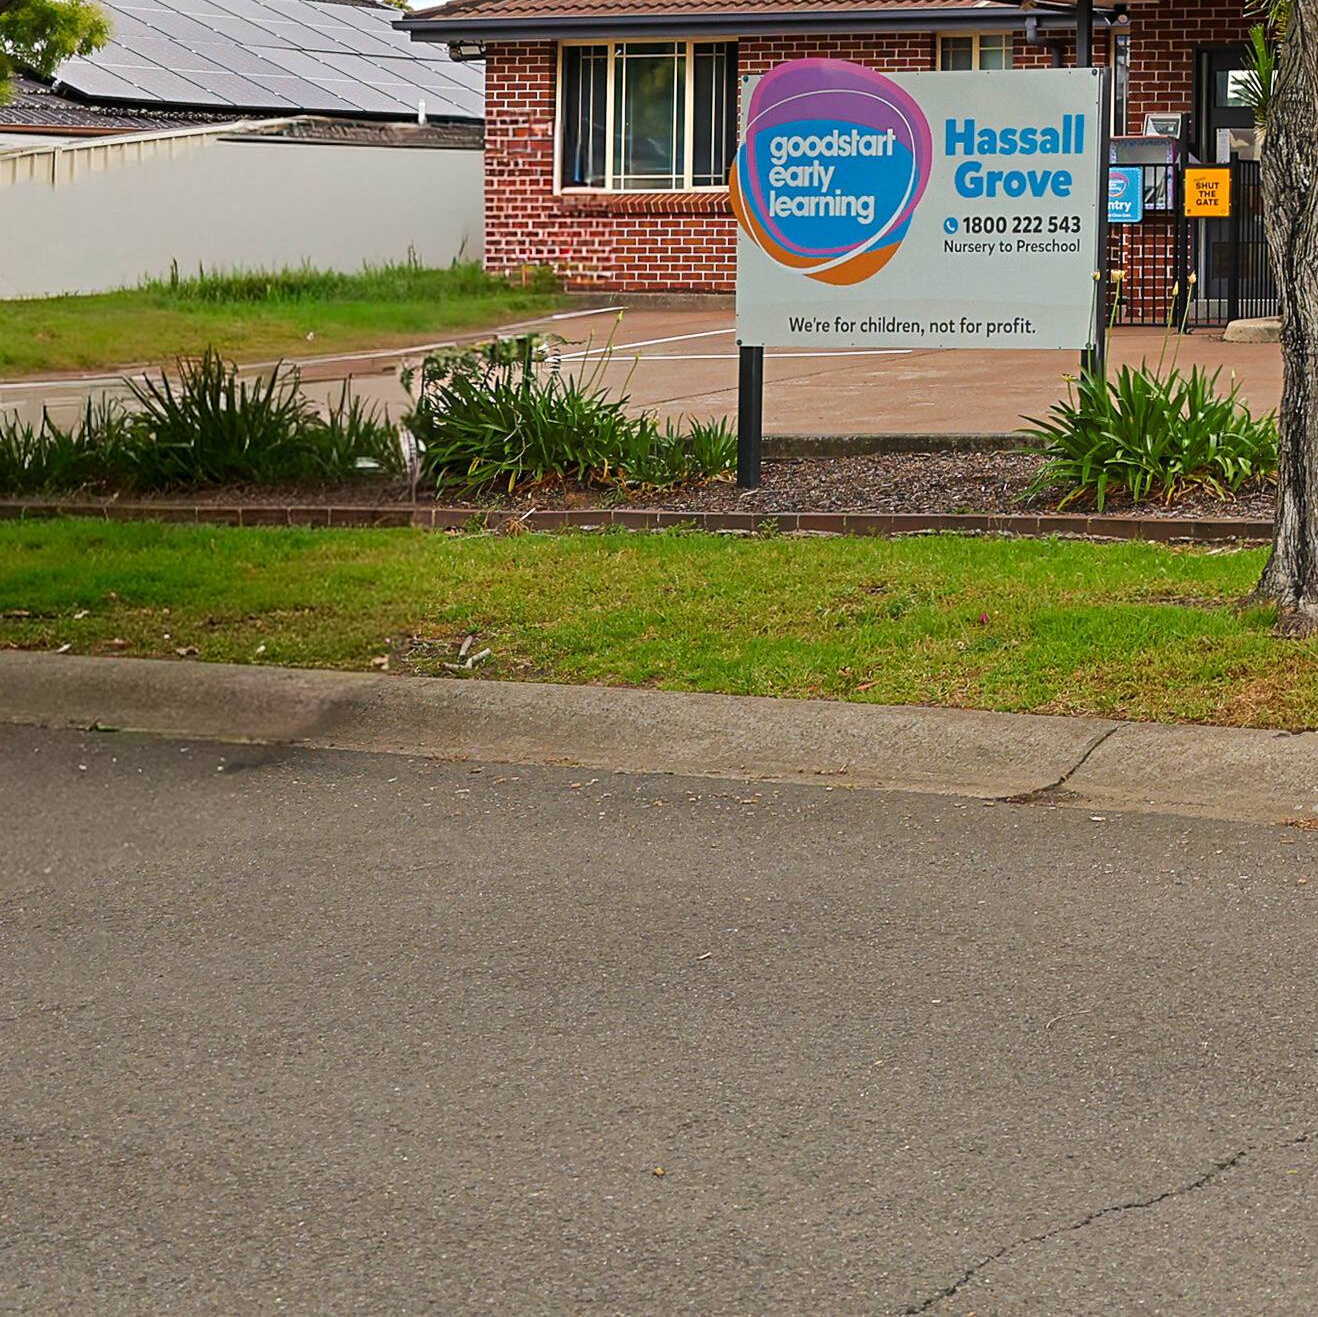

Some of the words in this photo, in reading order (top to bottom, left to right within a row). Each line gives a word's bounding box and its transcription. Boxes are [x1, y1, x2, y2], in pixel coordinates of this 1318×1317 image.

[945, 114, 1085, 156] Hassall
[769, 128, 896, 165] goodstart
[768, 159, 835, 193] early
[954, 161, 1073, 198] Grove
[1195, 182, 1219, 190] SHUT
[1198, 190, 1216, 198] THE
[769, 189, 875, 224] learning
[1108, 200, 1132, 212] ntry
[1195, 198, 1219, 207] GATE
[963, 216, 1007, 234] 1800
[1012, 216, 1043, 234] 222
[1047, 215, 1081, 233] 543
[944, 240, 995, 256] Nursery
[999, 241, 1012, 253] to
[1016, 238, 1080, 253] Preschool
[789, 317, 830, 333] We're
[834, 317, 856, 333] for
[860, 317, 925, 336] children,
[929, 320, 955, 334] not
[959, 317, 982, 334] for
[986, 318, 1036, 337] profit.
